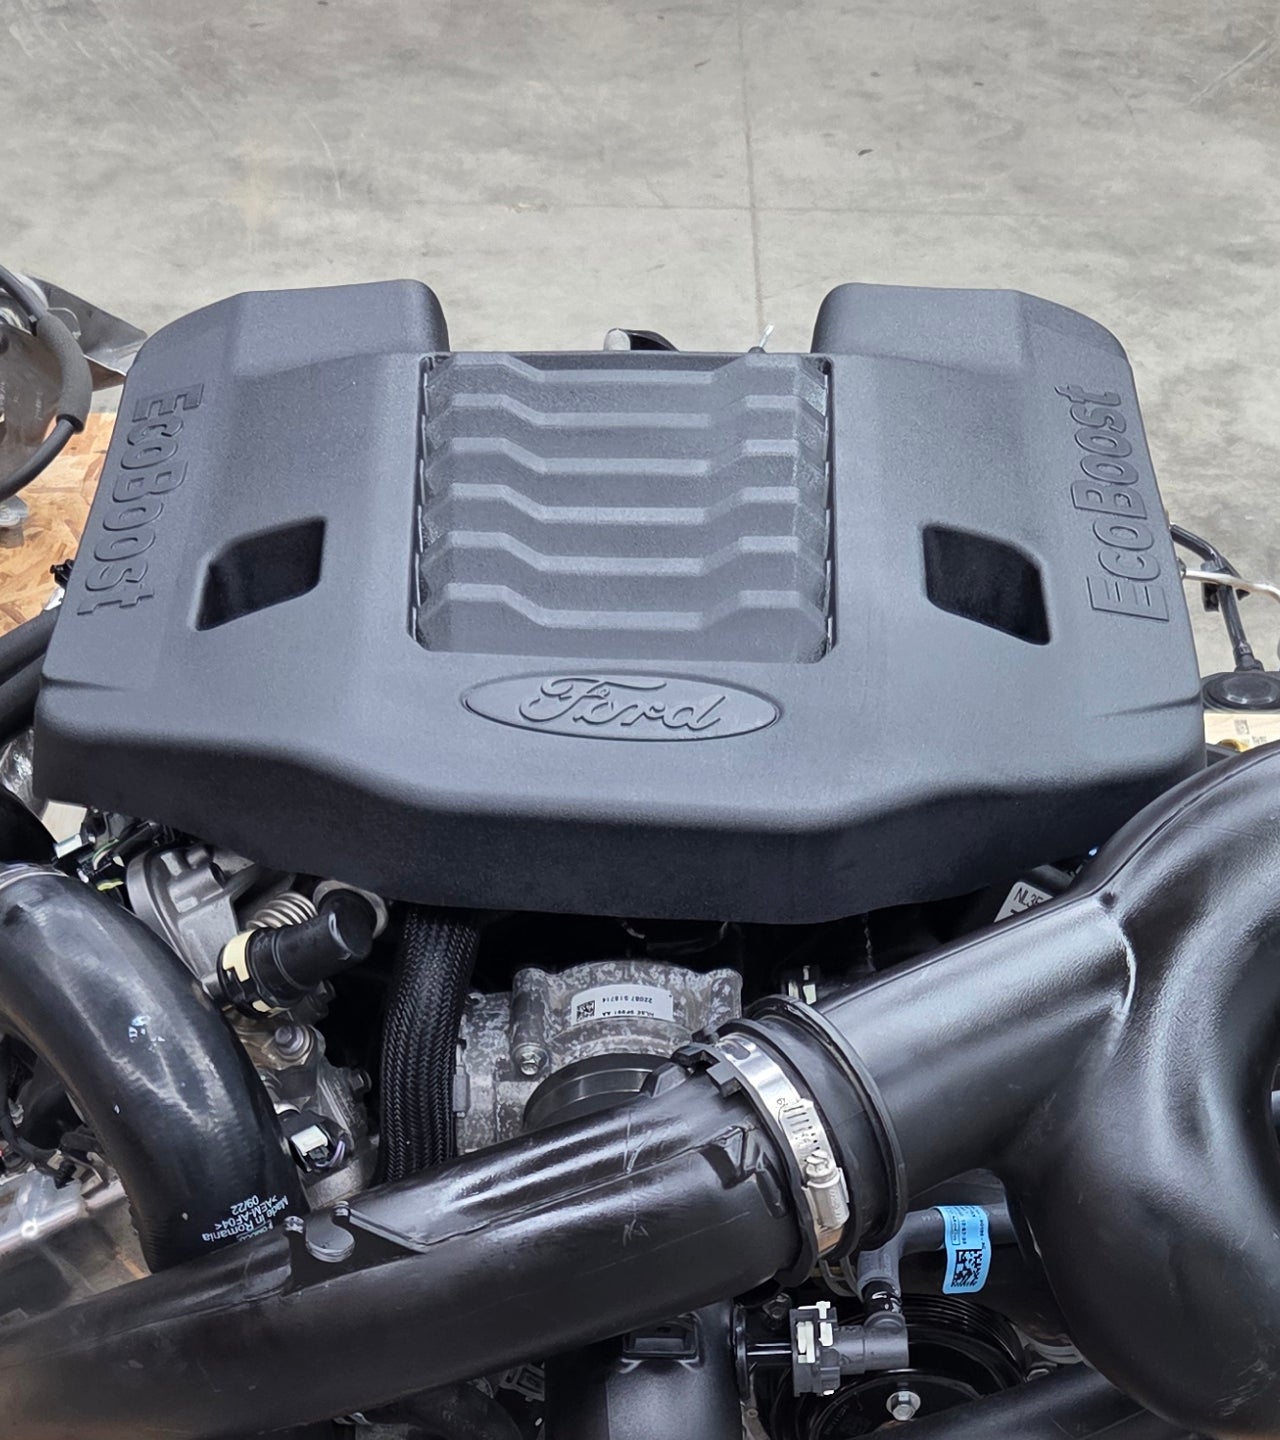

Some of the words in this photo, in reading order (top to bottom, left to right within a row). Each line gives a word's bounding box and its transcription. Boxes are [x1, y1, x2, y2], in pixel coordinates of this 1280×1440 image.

[78, 385, 205, 618] EcoBoost
[1057, 383, 1170, 624] EcoBoost
[519, 676, 725, 731] Ford
[214, 1194, 278, 1230] >AEM-AF04<
[230, 1194, 260, 1216] 09/22
[255, 1214, 266, 1225] in
[266, 1194, 289, 1218] Made
[202, 1219, 255, 1242] Romania
